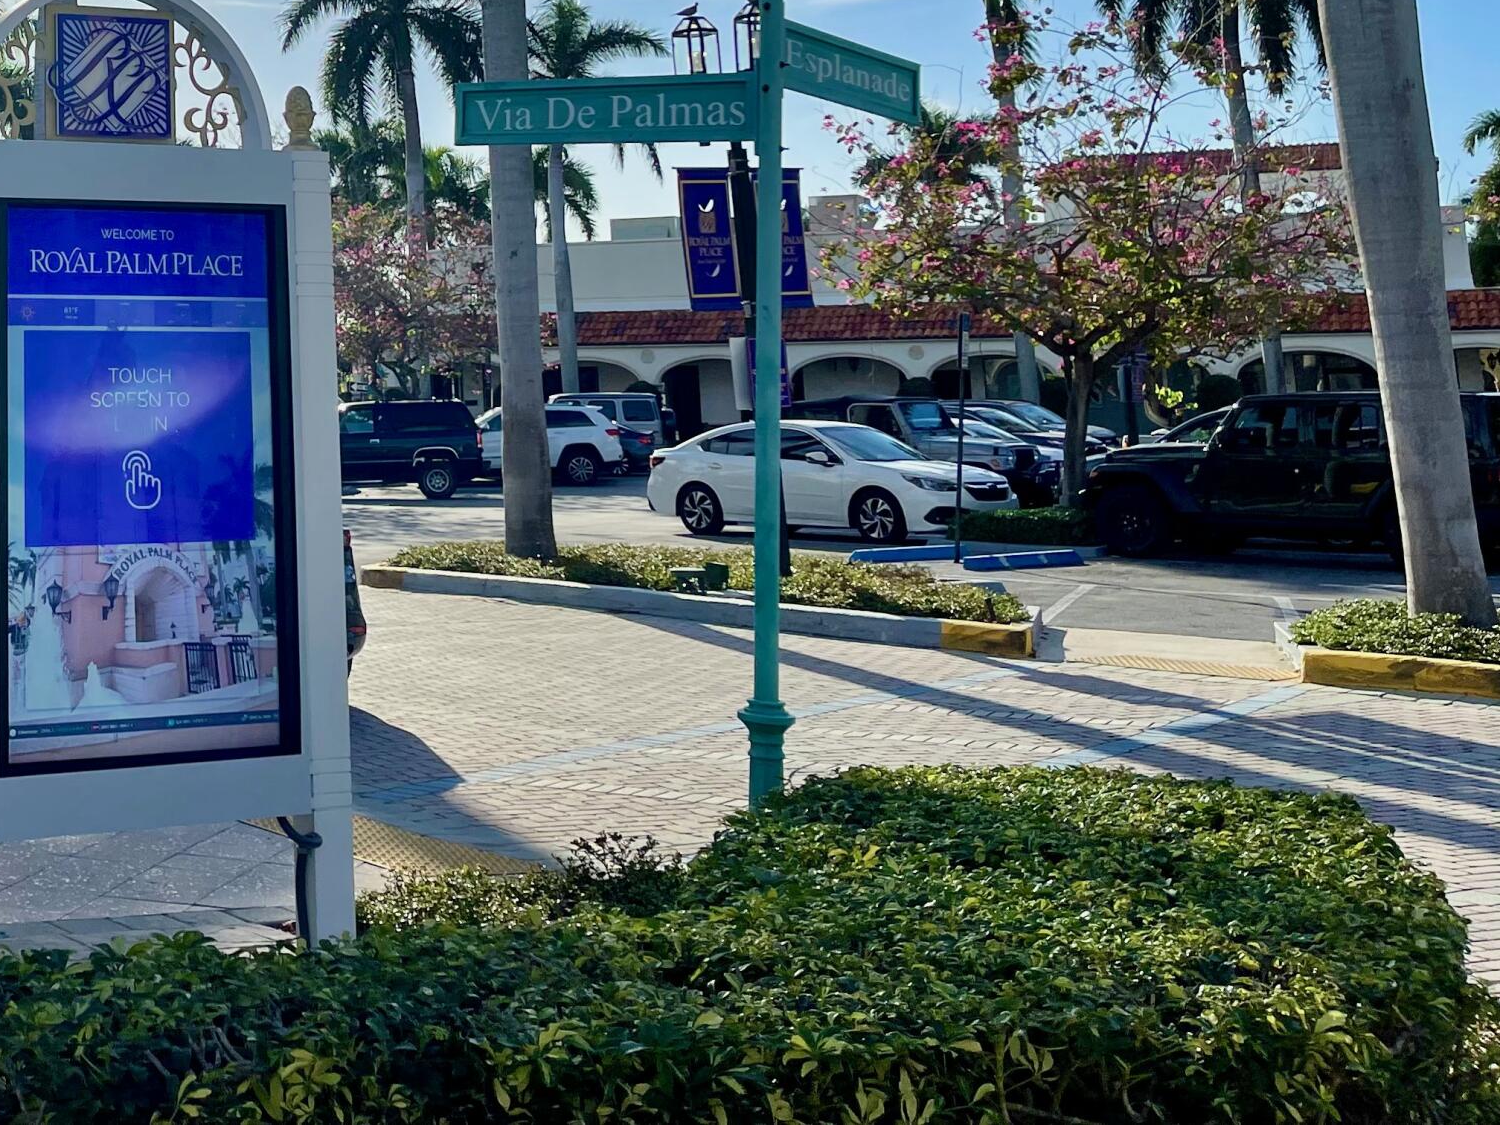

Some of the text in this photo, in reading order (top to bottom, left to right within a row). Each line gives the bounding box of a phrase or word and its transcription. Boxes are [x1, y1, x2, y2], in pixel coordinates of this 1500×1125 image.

[786, 38, 911, 102] Esplanade
[475, 93, 746, 132] Via De Palmas
[100, 227, 175, 242] WELCOME TO
[29, 246, 244, 276] ROYAL PALM PLACE
[107, 367, 172, 384] TOUCH
[165, 391, 190, 408] TO
[114, 547, 147, 580] ROYAL
[147, 546, 173, 561] PALM
